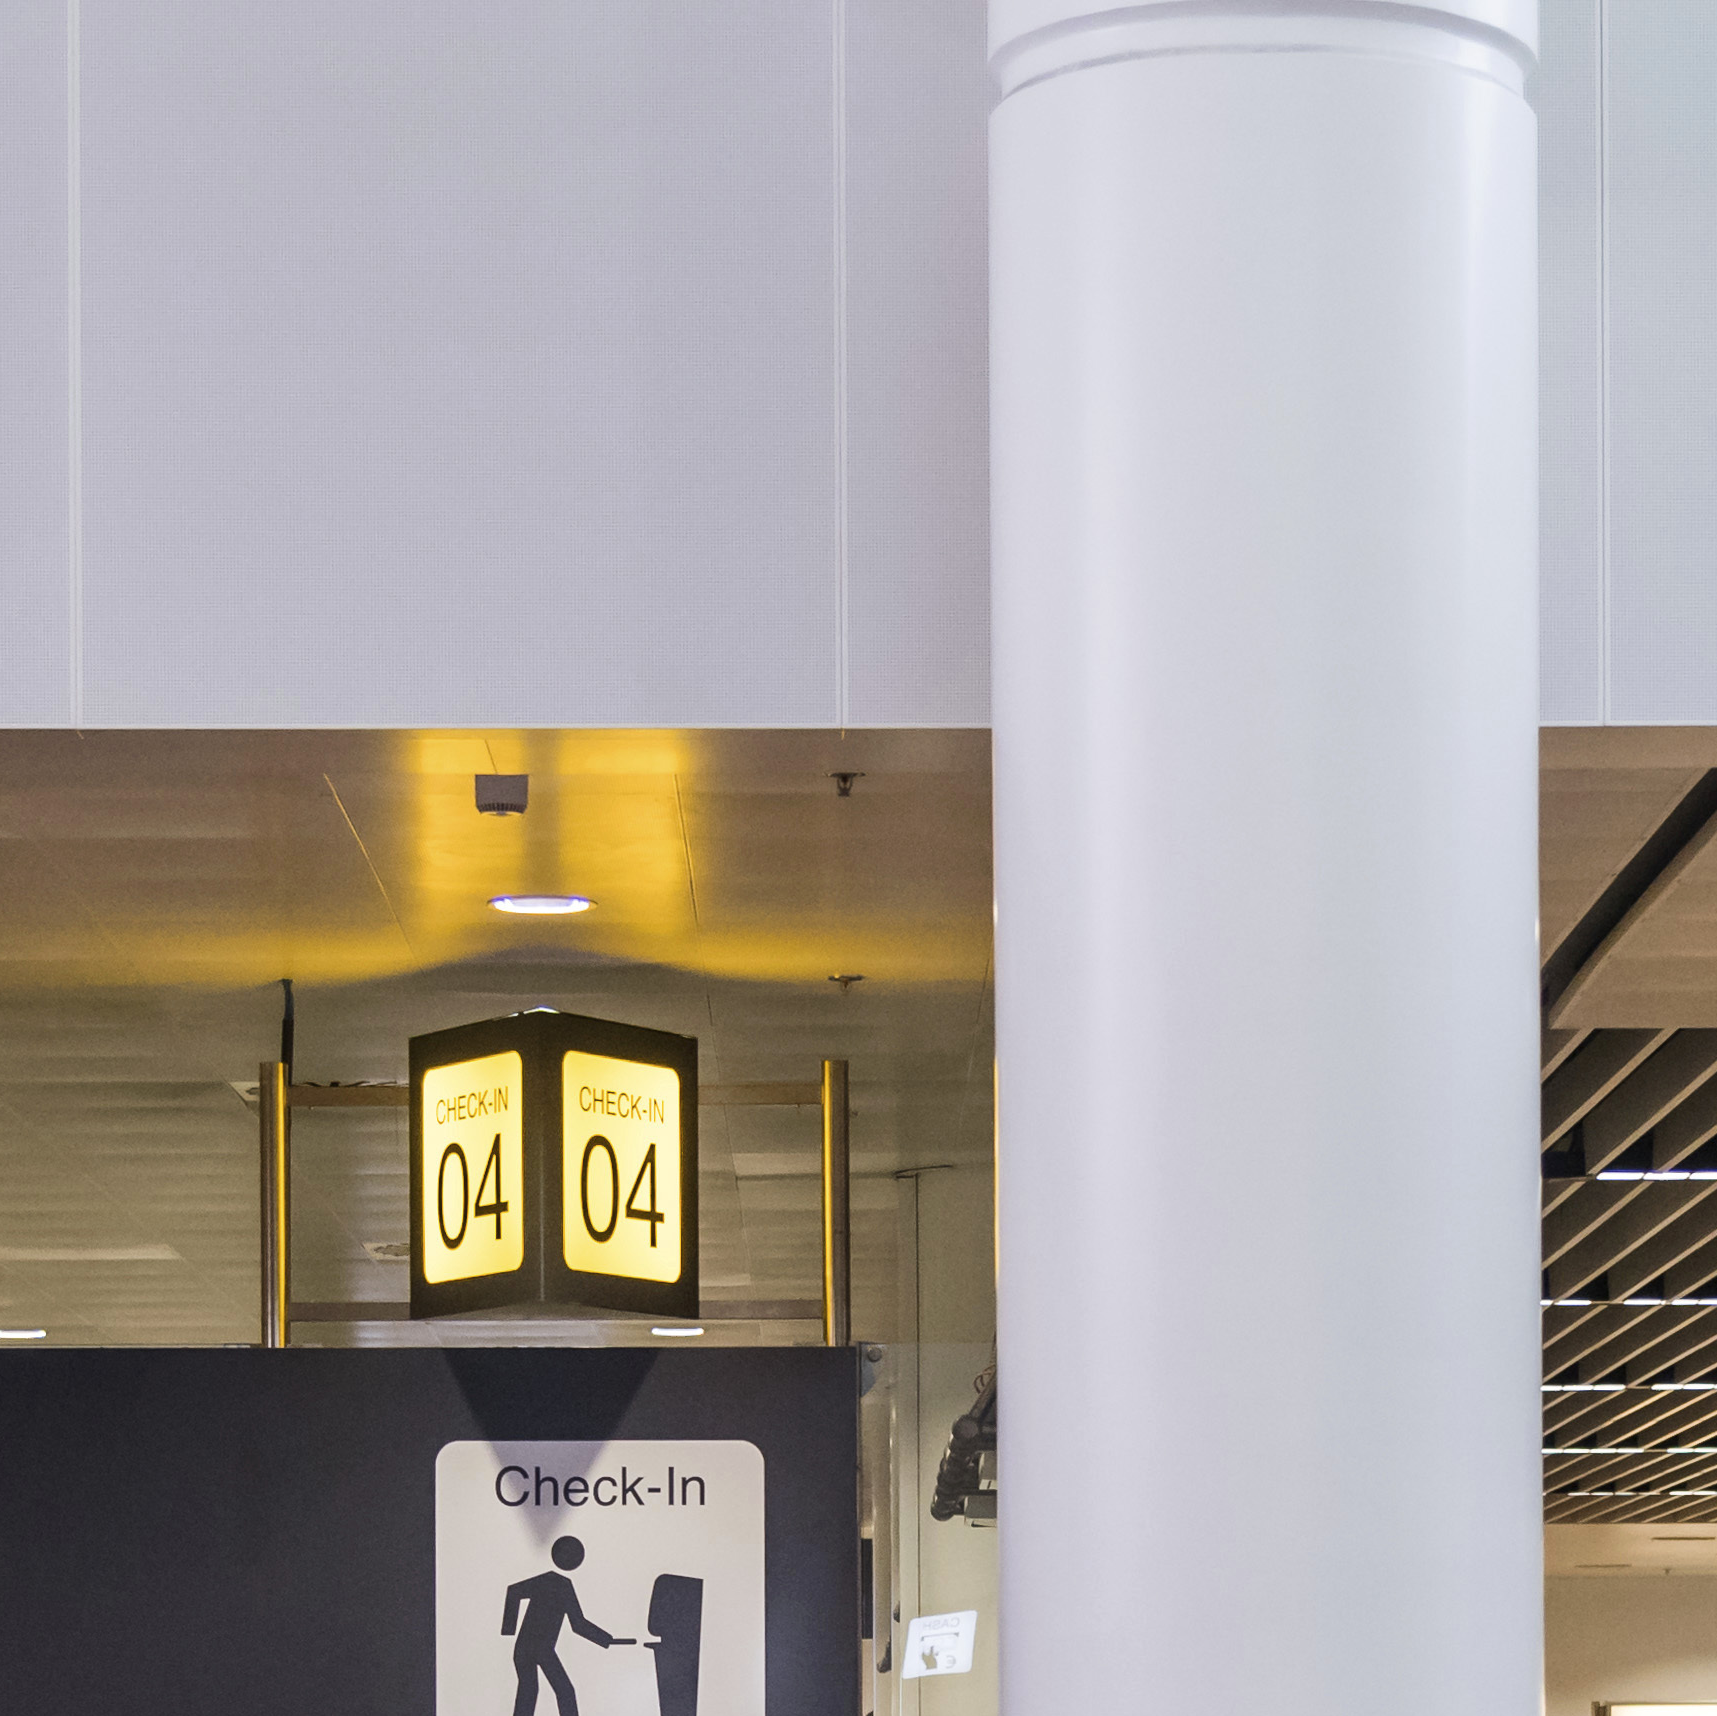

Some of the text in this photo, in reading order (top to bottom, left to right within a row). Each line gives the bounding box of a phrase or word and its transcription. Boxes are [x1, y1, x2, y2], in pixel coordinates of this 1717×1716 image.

[436, 1086, 509, 1125] CHECK-IN
[578, 1086, 665, 1124] CHECK-IN
[437, 1133, 509, 1250] 04
[580, 1134, 665, 1248] 04
[494, 1465, 707, 1507] Check-In
